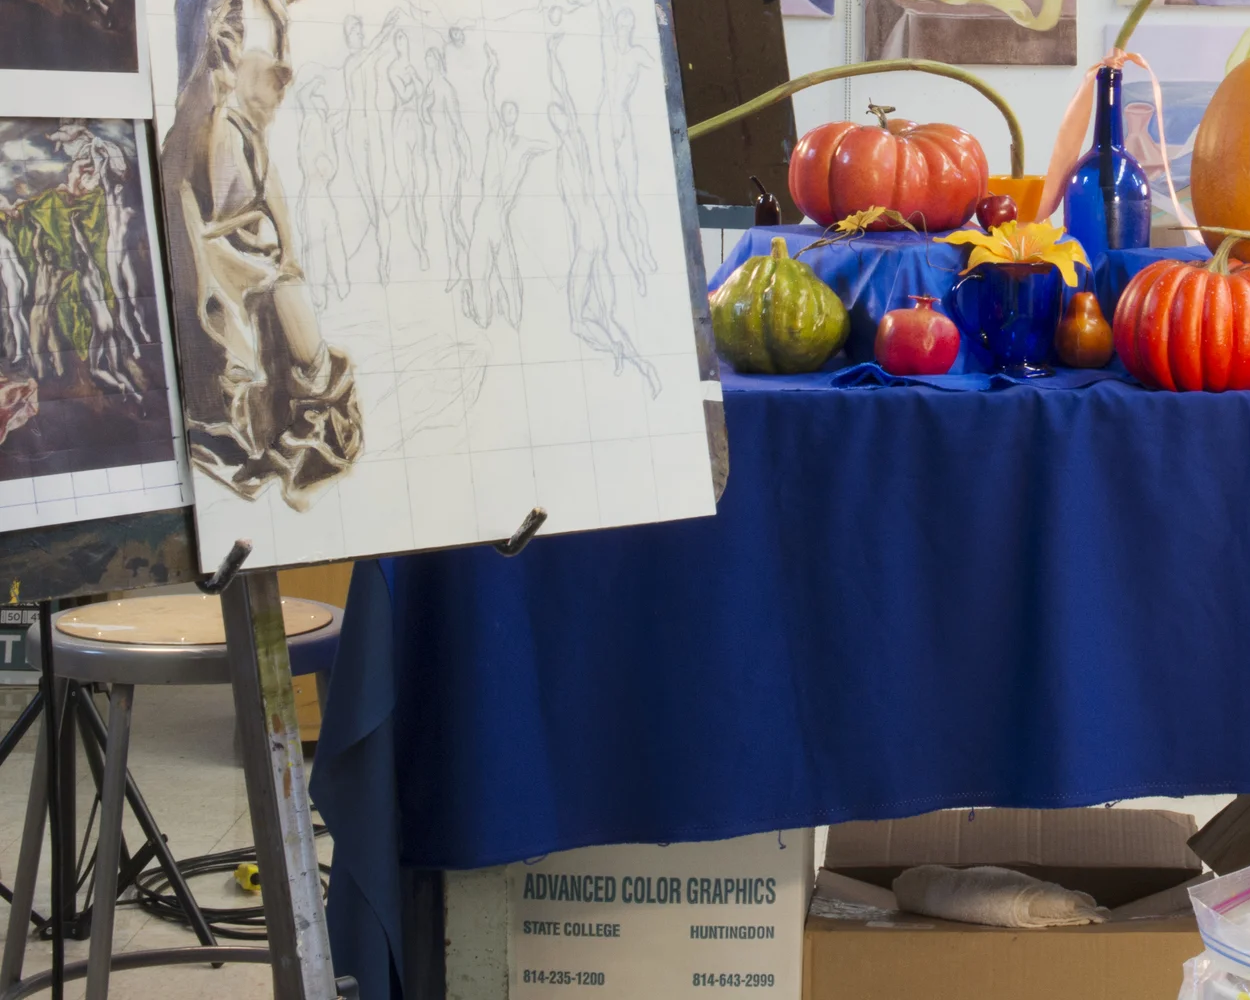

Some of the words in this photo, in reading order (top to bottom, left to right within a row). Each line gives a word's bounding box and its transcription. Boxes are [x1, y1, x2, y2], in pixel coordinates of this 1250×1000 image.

[7, 612, 21, 622] 50
[523, 872, 616, 903] ADVANCED
[621, 876, 682, 905] COLOR
[686, 877, 777, 906] GRAPHICS
[523, 920, 561, 937] STATE
[563, 922, 621, 938] COLLEGE
[690, 925, 775, 940] HUNTINGDON
[523, 969, 605, 987] 814-235-1200
[692, 973, 775, 988] 814-643-2999
